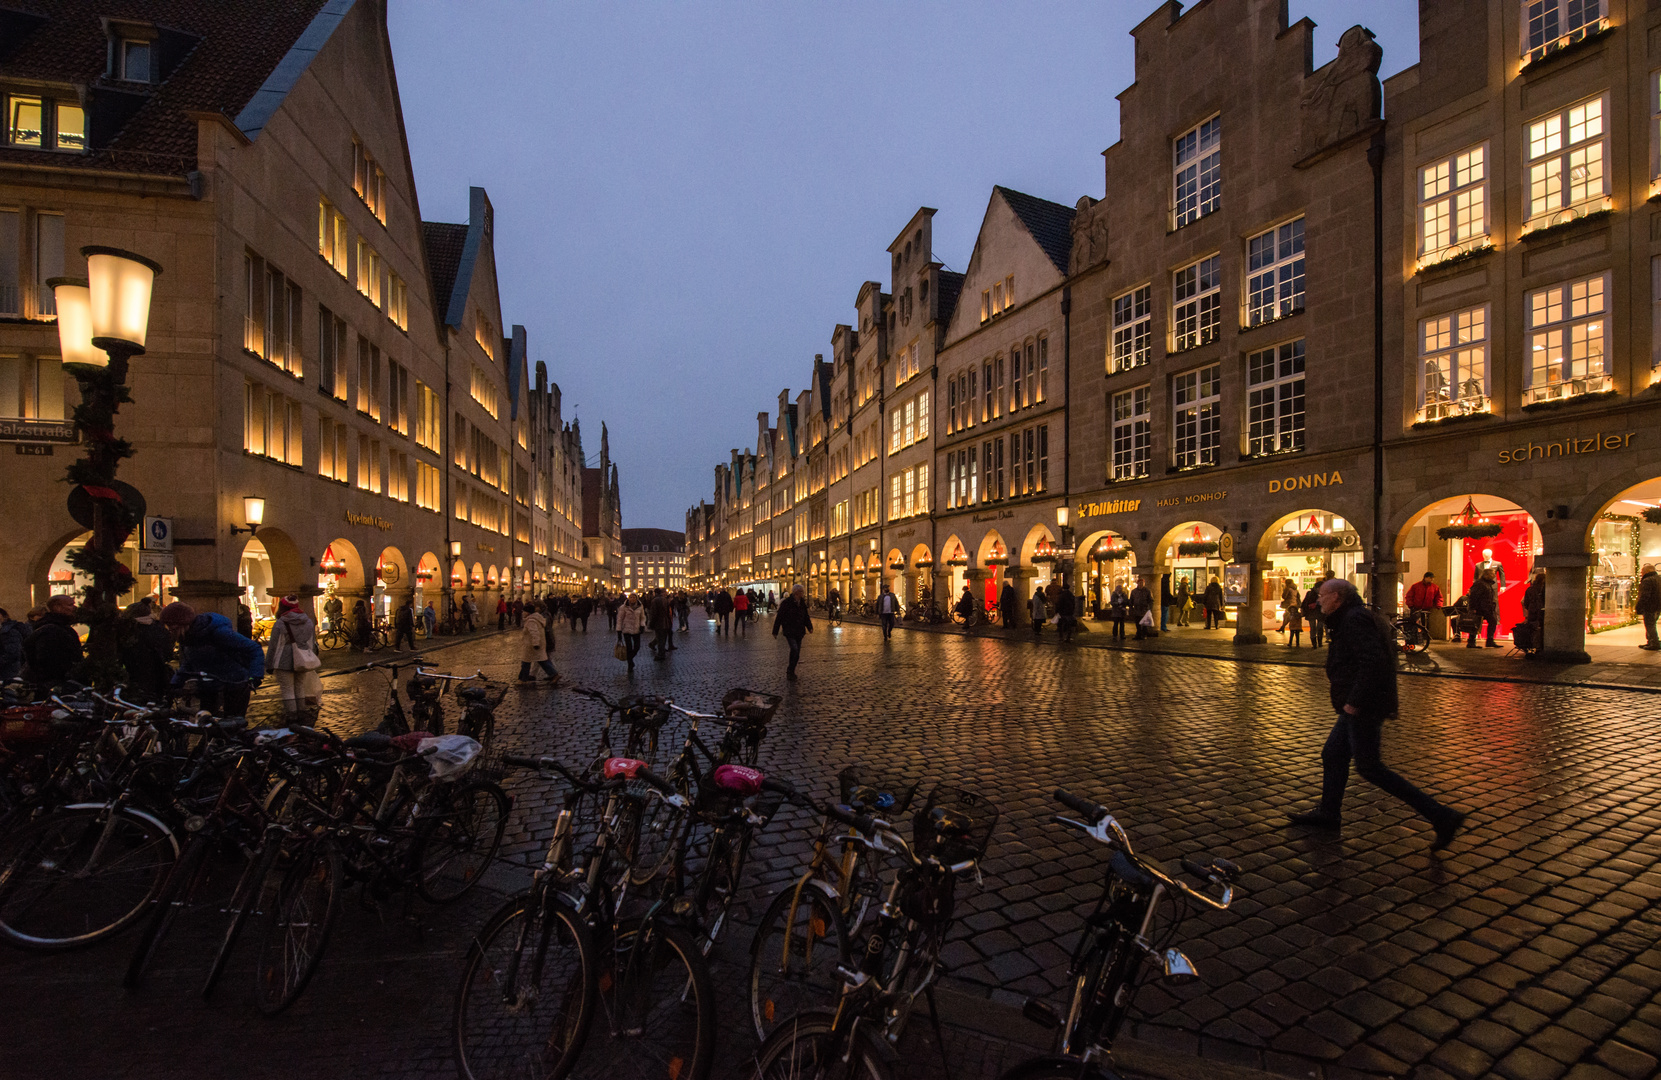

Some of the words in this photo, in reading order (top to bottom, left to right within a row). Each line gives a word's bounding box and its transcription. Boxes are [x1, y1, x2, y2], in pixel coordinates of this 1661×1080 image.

[1498, 432, 1636, 464] schnitzler
[1268, 470, 1344, 494] DONNA
[1087, 499, 1142, 517] Tollkötter
[1156, 497, 1181, 507] HAUS
[1184, 491, 1228, 504] MONHOF
